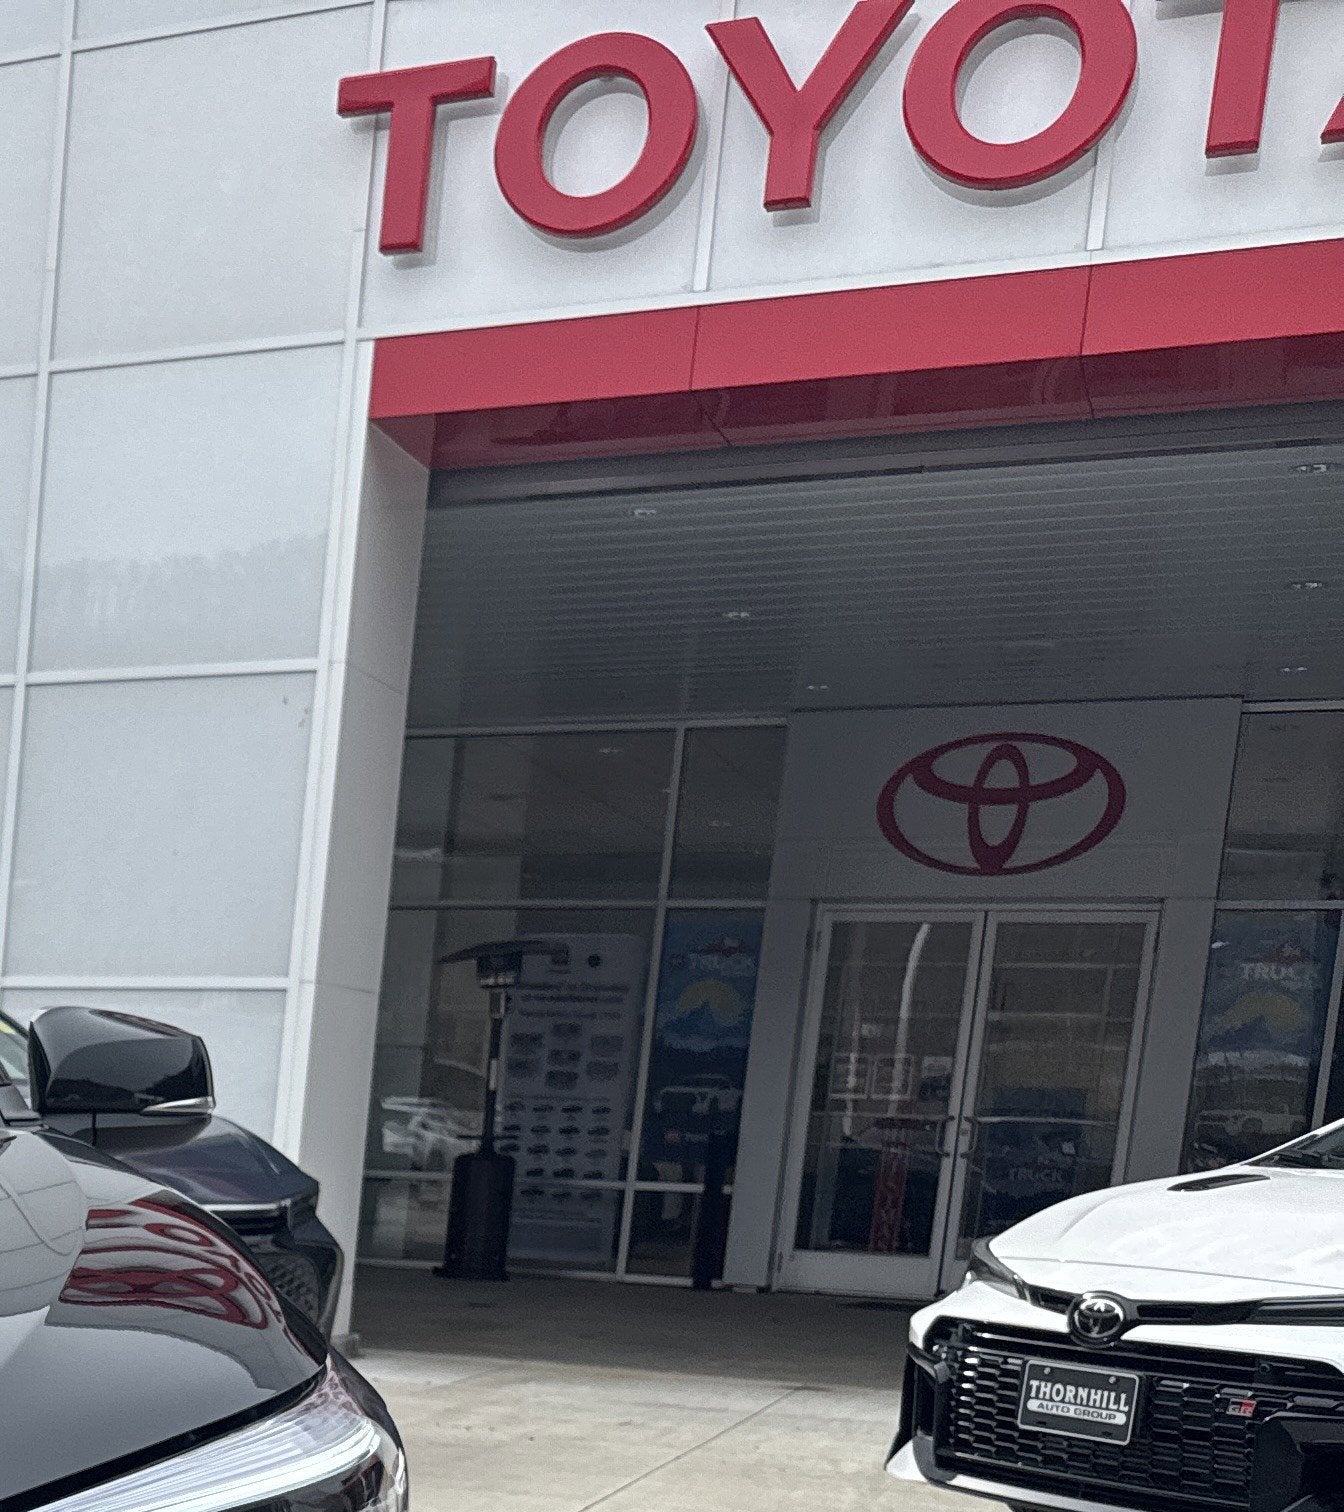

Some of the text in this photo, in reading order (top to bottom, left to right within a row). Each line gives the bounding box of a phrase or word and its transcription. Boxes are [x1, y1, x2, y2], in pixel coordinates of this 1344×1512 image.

[337, 0, 1344, 256] TOYOT
[1029, 1379, 1129, 1412] THORNHILL
[1037, 1402, 1117, 1421] AUTO GROUP
